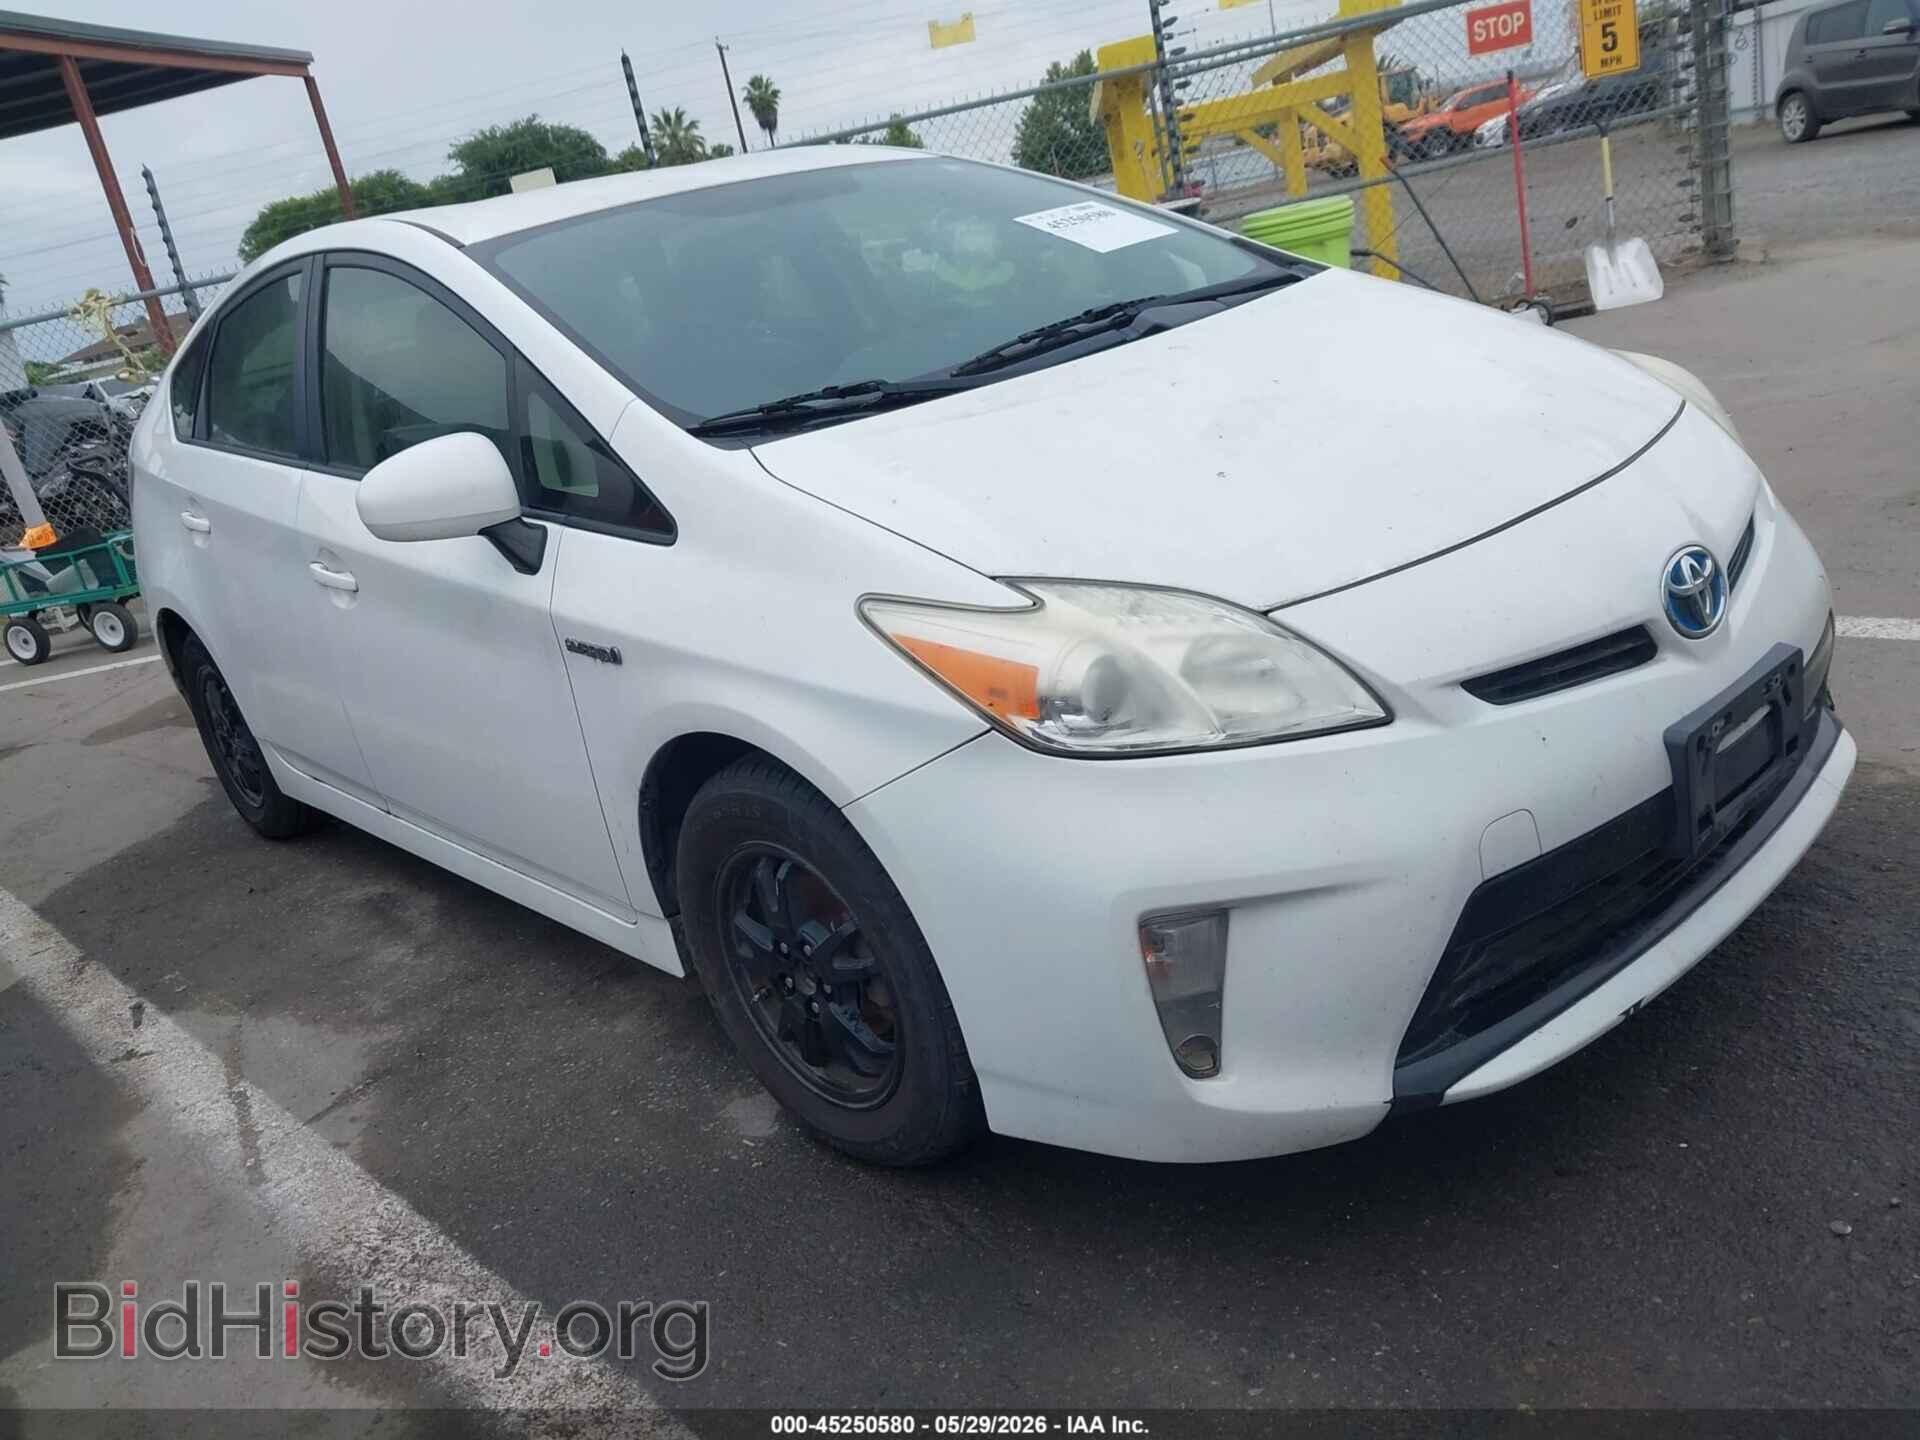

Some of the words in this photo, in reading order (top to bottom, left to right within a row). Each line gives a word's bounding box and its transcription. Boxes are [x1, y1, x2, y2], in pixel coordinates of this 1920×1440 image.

[1472, 10, 1525, 44] STOP
[1593, 4, 1623, 21] LIMIT
[1601, 21, 1618, 53] 5
